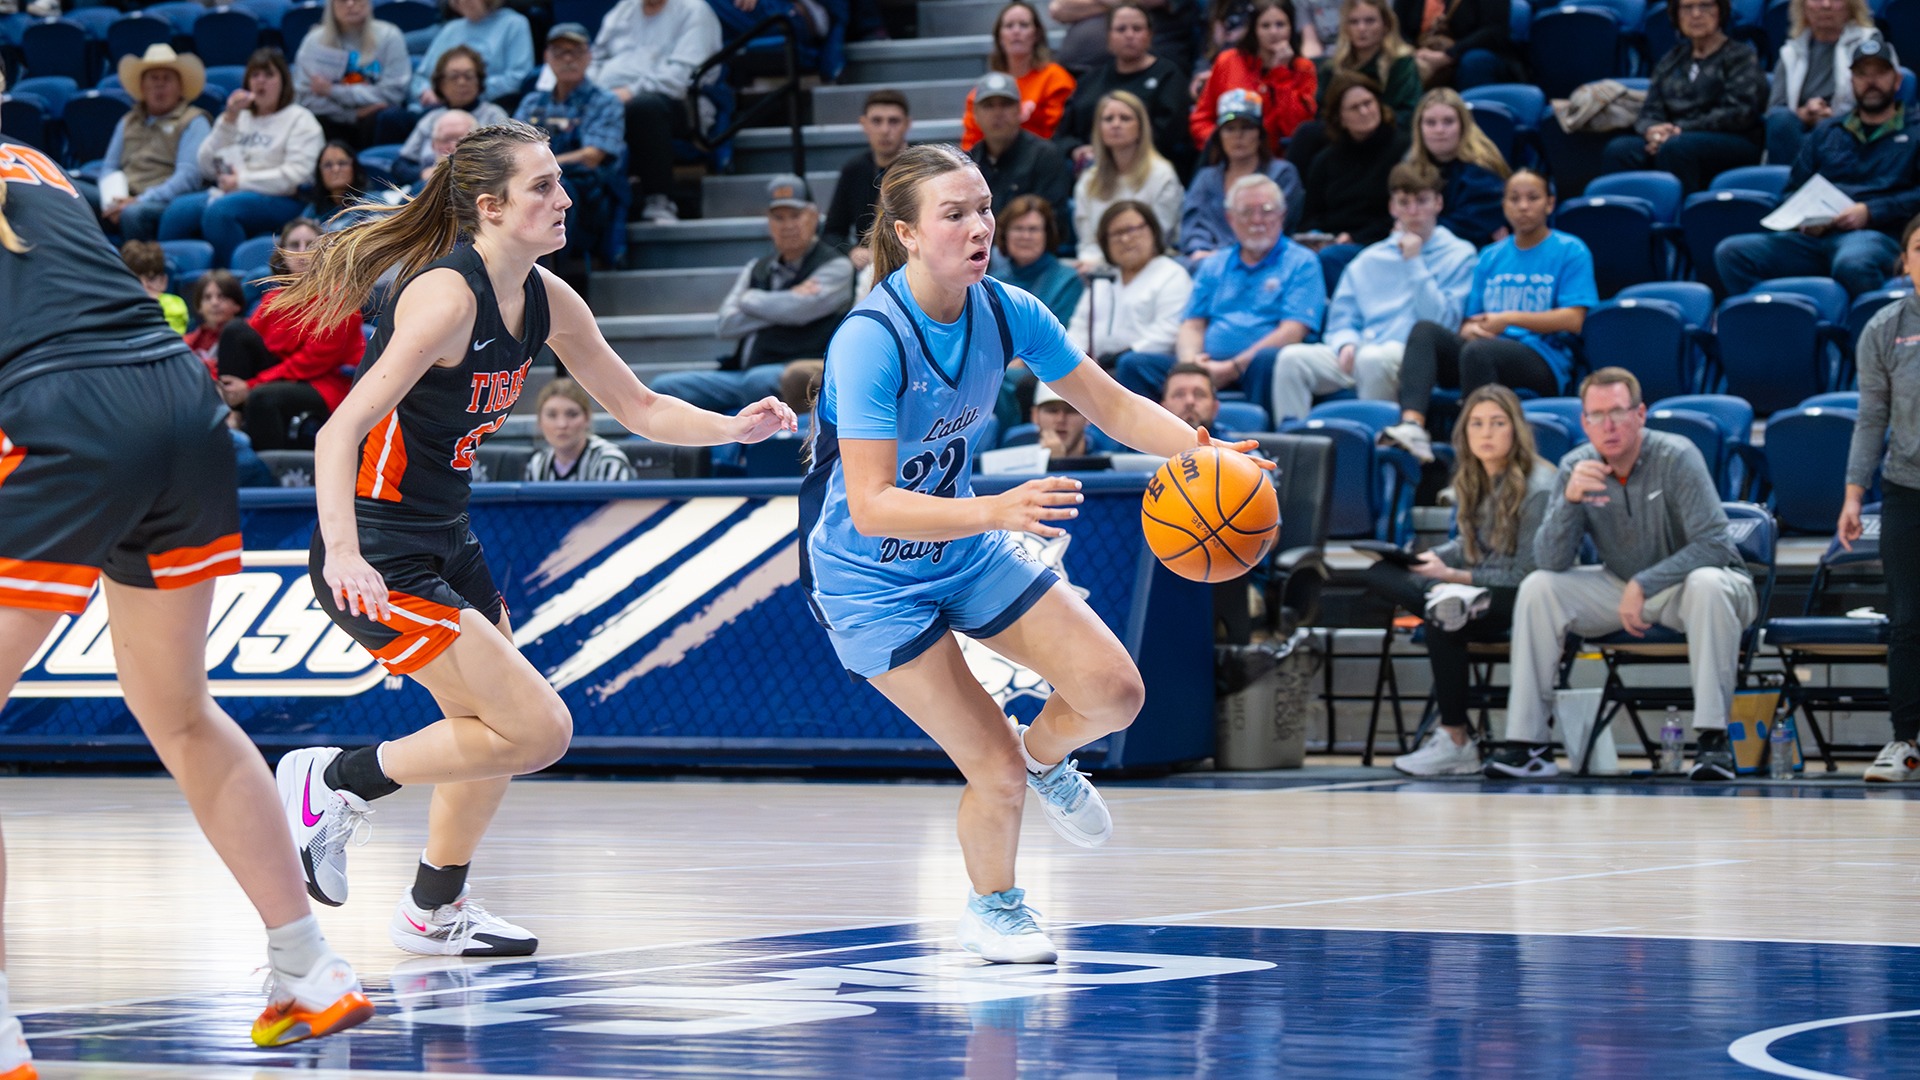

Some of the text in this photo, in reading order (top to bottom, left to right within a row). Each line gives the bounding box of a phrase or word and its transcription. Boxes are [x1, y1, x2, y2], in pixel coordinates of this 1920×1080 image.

[922, 405, 979, 443] Lady
[901, 436, 968, 499] 22
[879, 537, 953, 564] Dawg
[384, 676, 403, 690] TM
